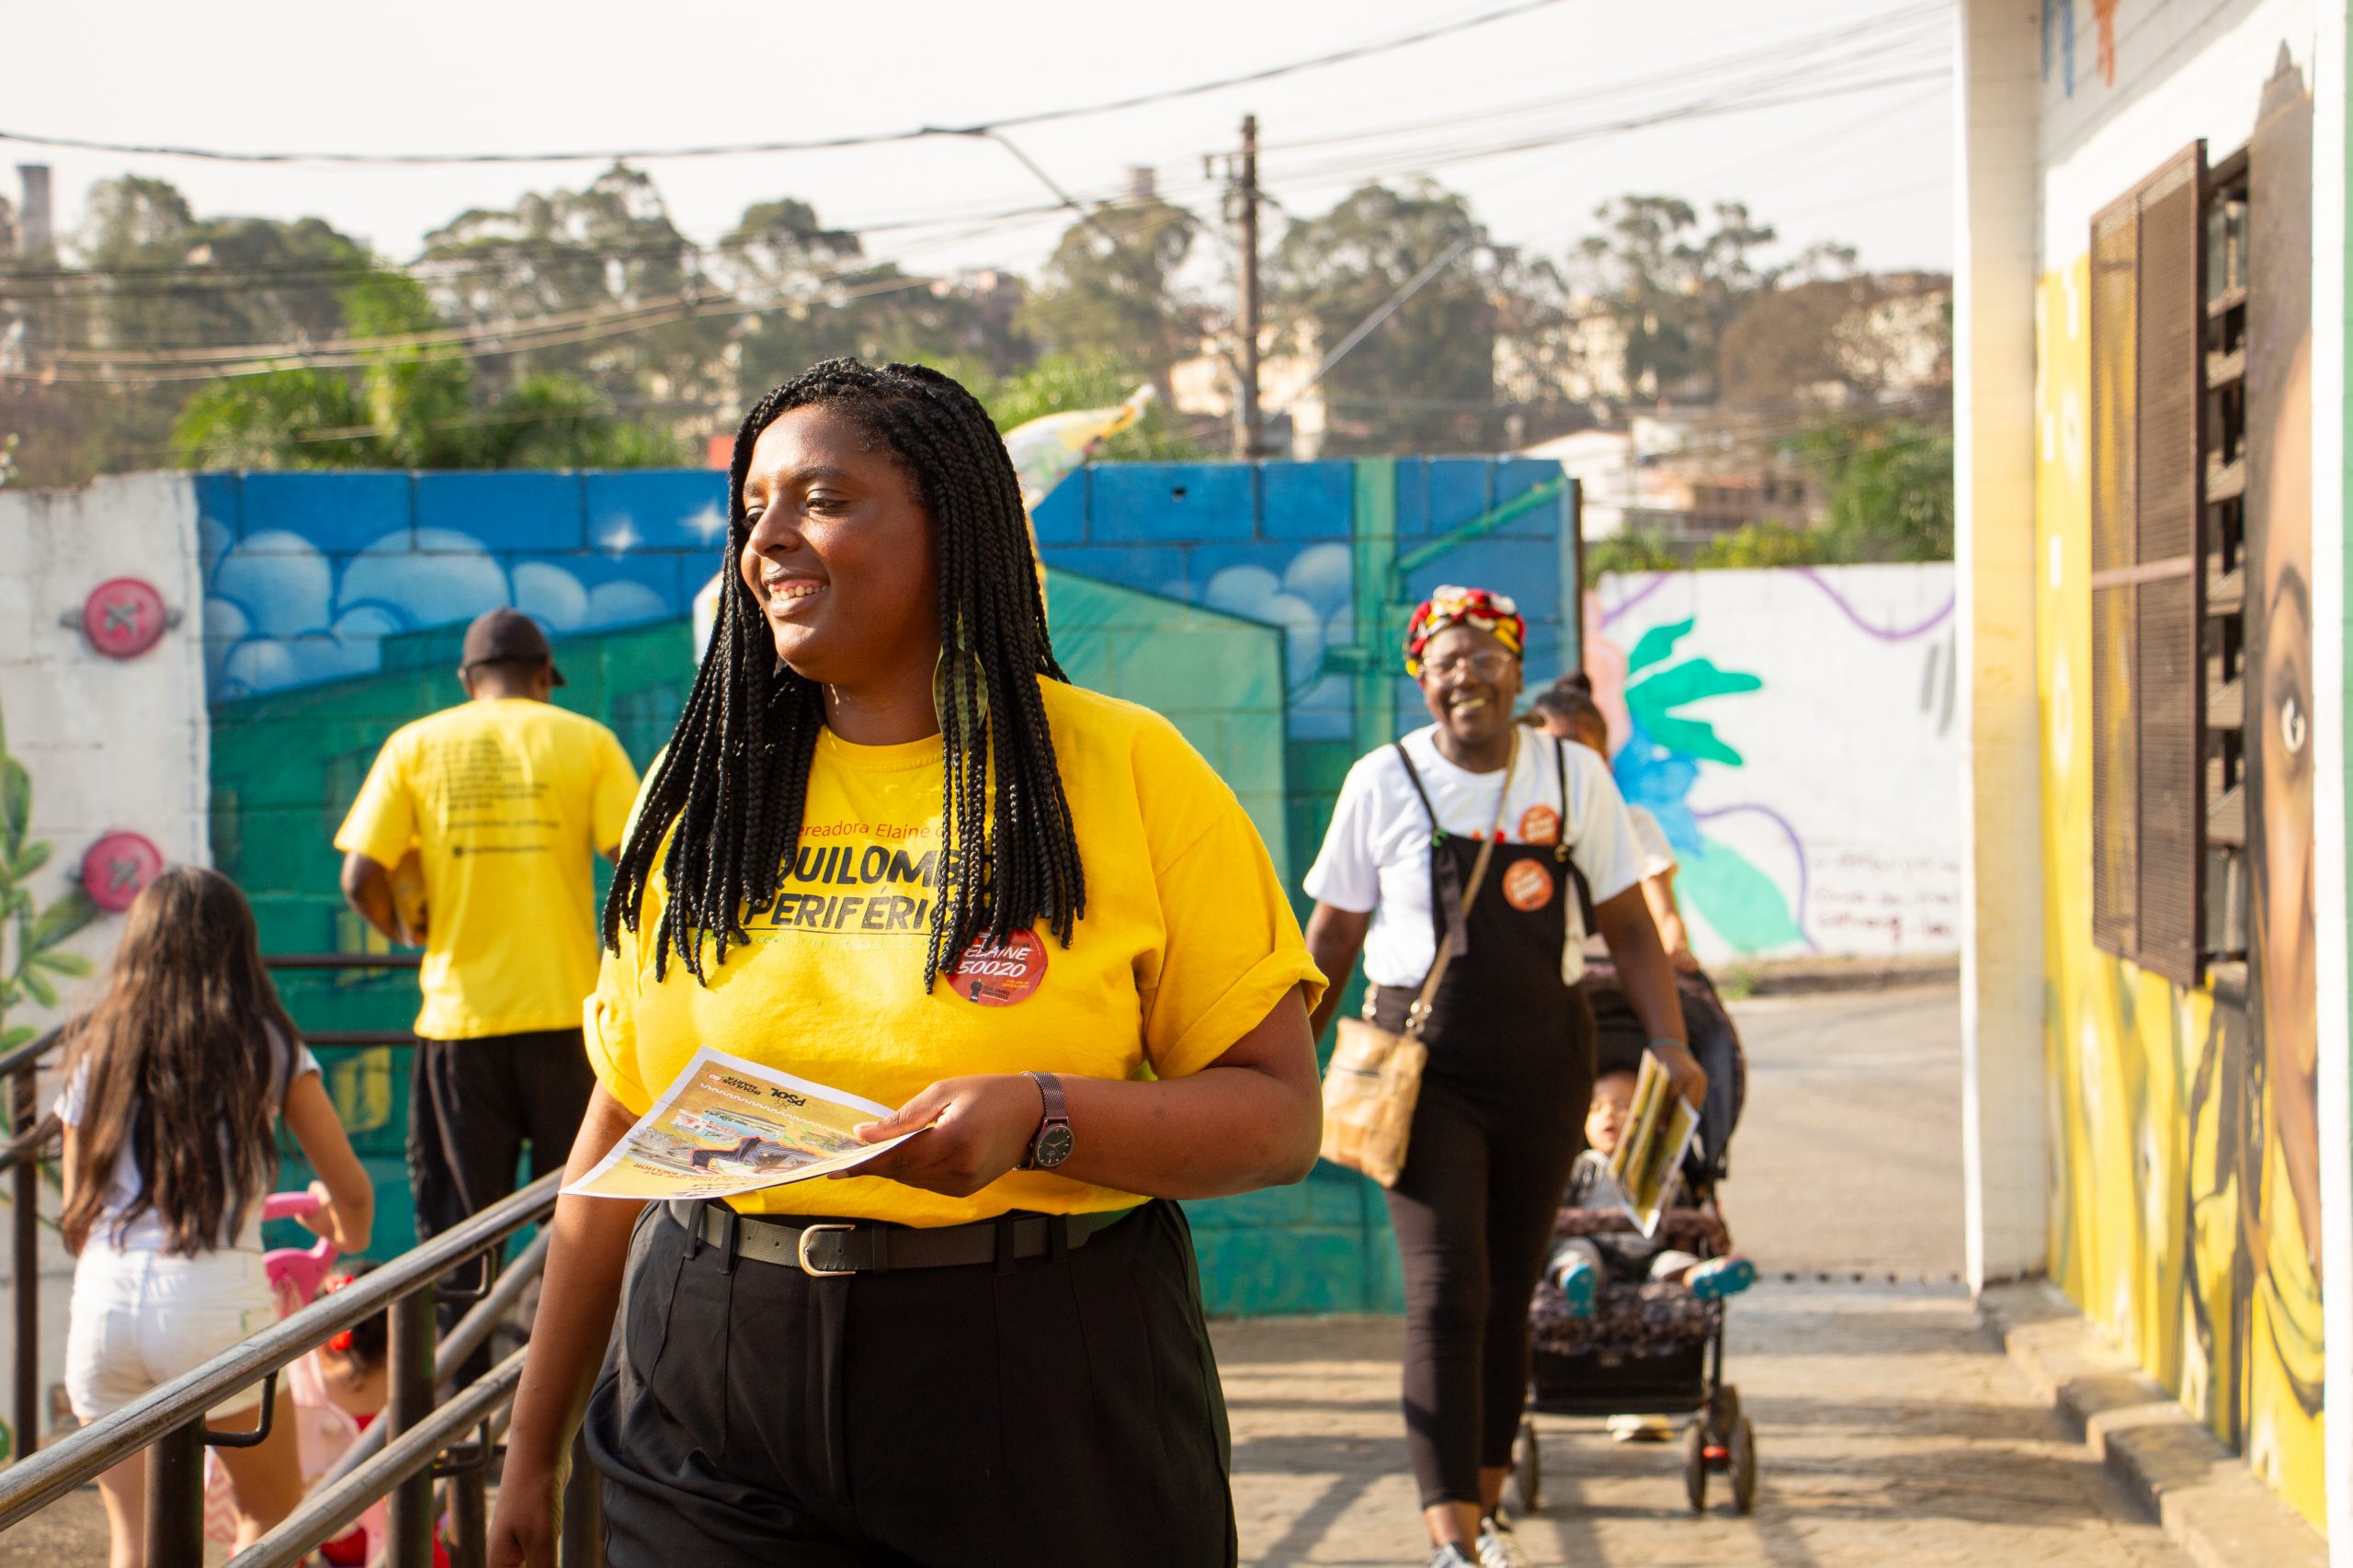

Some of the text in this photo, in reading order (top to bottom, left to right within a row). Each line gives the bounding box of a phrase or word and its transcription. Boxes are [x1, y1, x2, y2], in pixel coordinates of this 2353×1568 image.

[799, 820, 869, 837] ereadora
[876, 824, 930, 838] Elaine
[774, 846, 993, 890] QUILOMB
[743, 885, 959, 932] PERIFÉRIC
[956, 960, 1027, 978] 50020
[722, 1079, 762, 1096] BOULOS
[770, 1087, 807, 1107] PSOL
